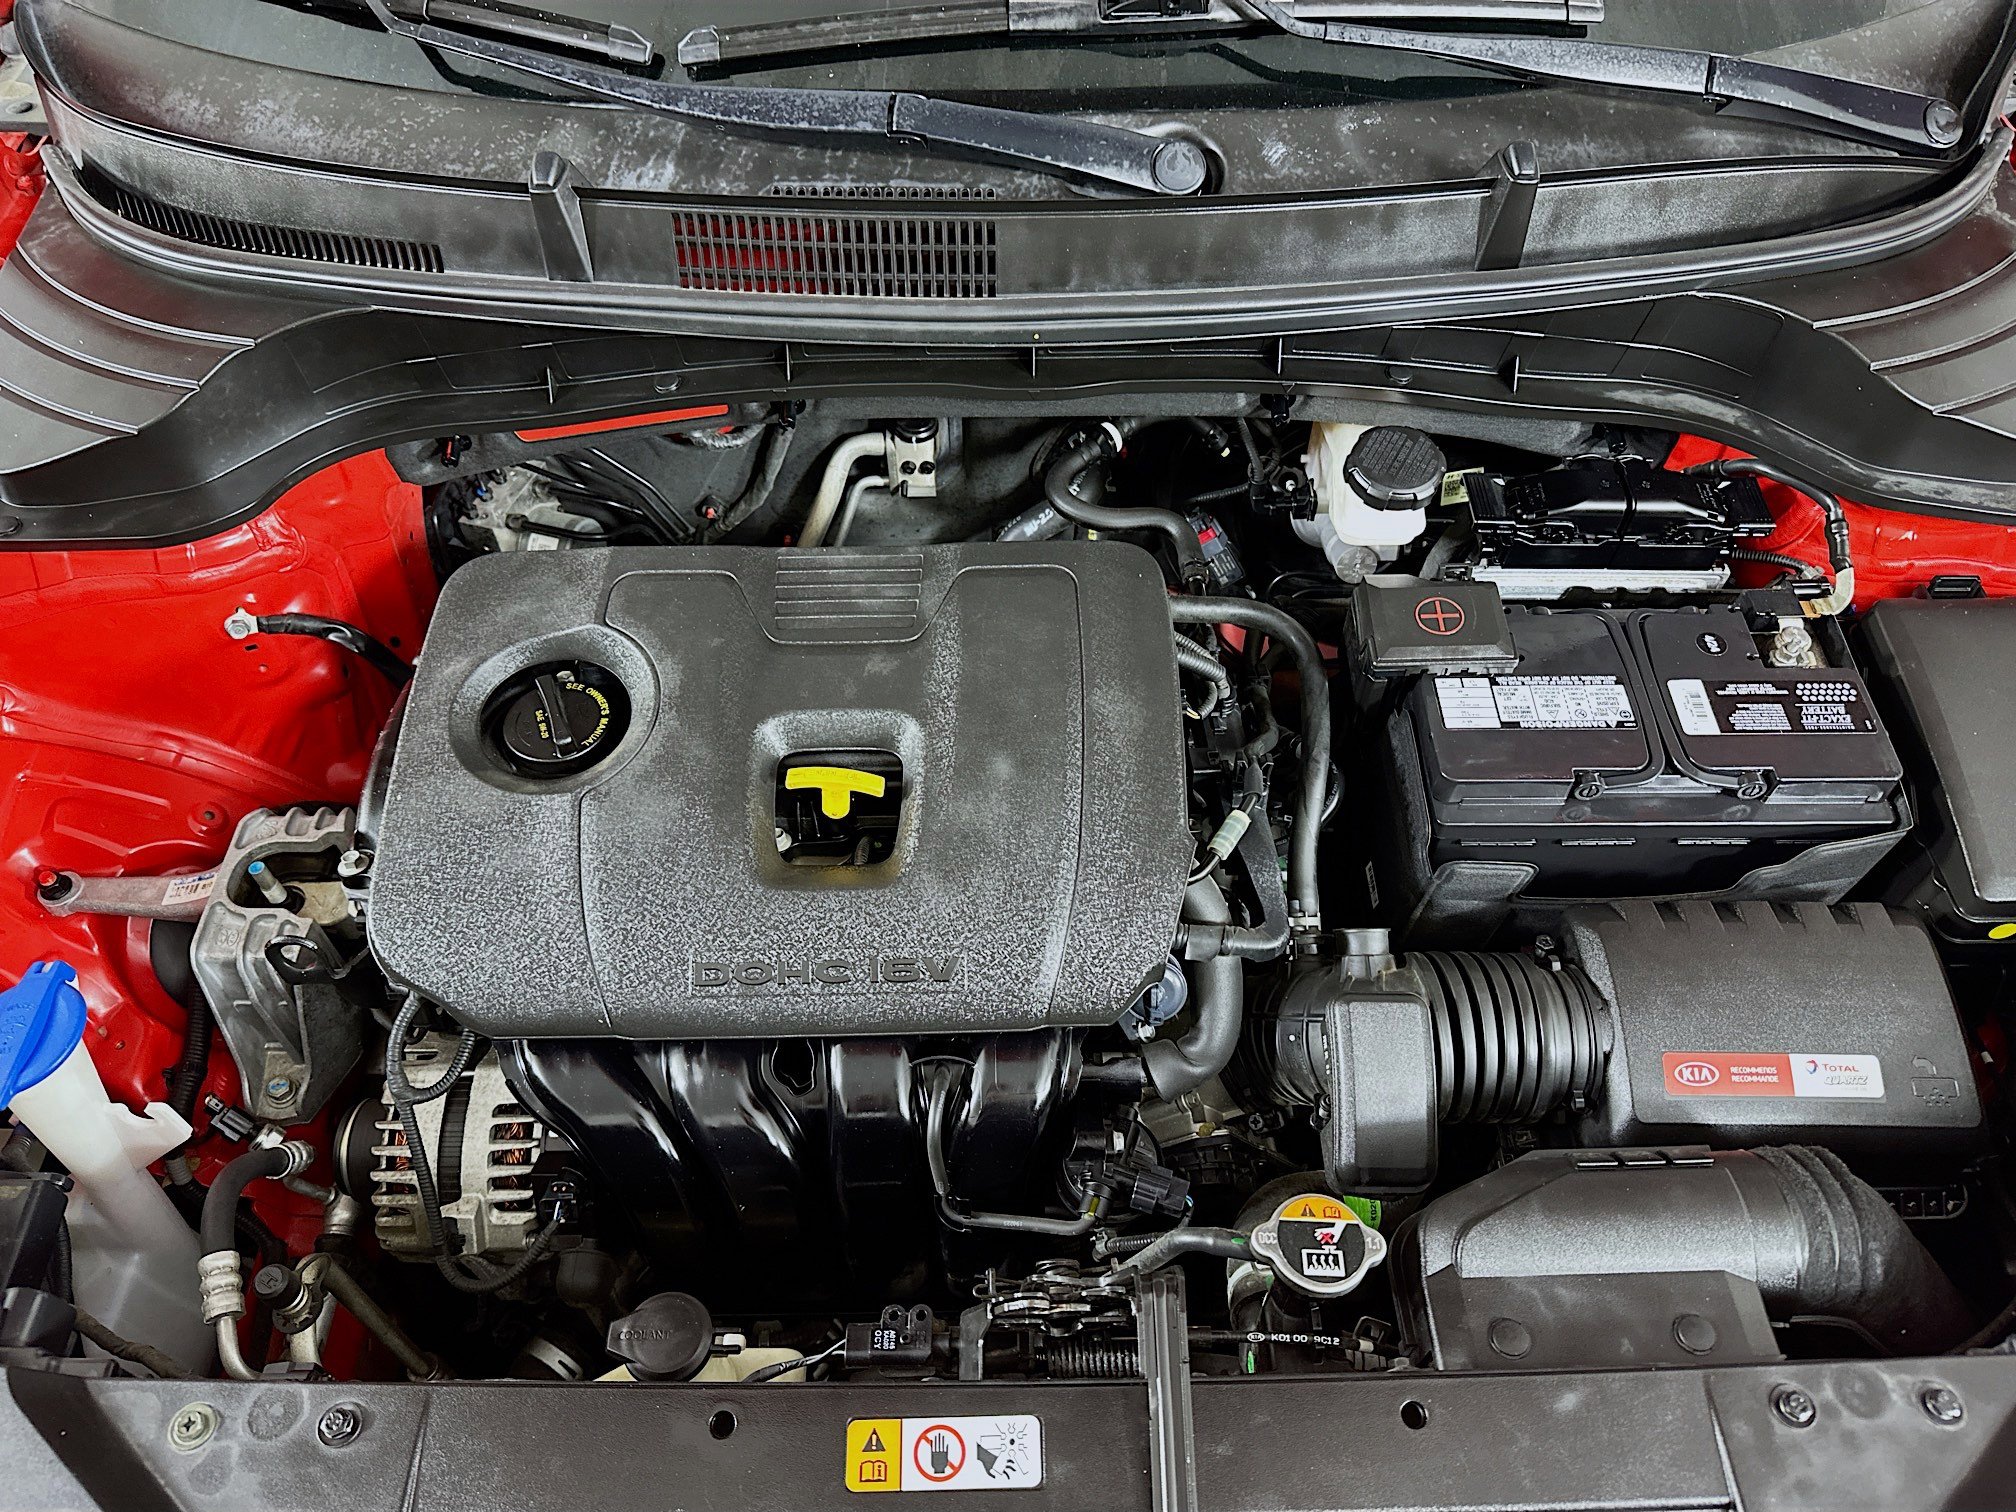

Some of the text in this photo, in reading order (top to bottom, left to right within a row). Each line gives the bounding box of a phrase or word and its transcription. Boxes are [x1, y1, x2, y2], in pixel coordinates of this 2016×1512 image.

[565, 682, 610, 747] SEE OWNER'S MANUAL
[1800, 706, 1846, 715] BATTERY
[692, 956, 961, 987] DOHC 16V
[1681, 1066, 1714, 1083] KIA
[619, 1329, 671, 1340] COOLANT
